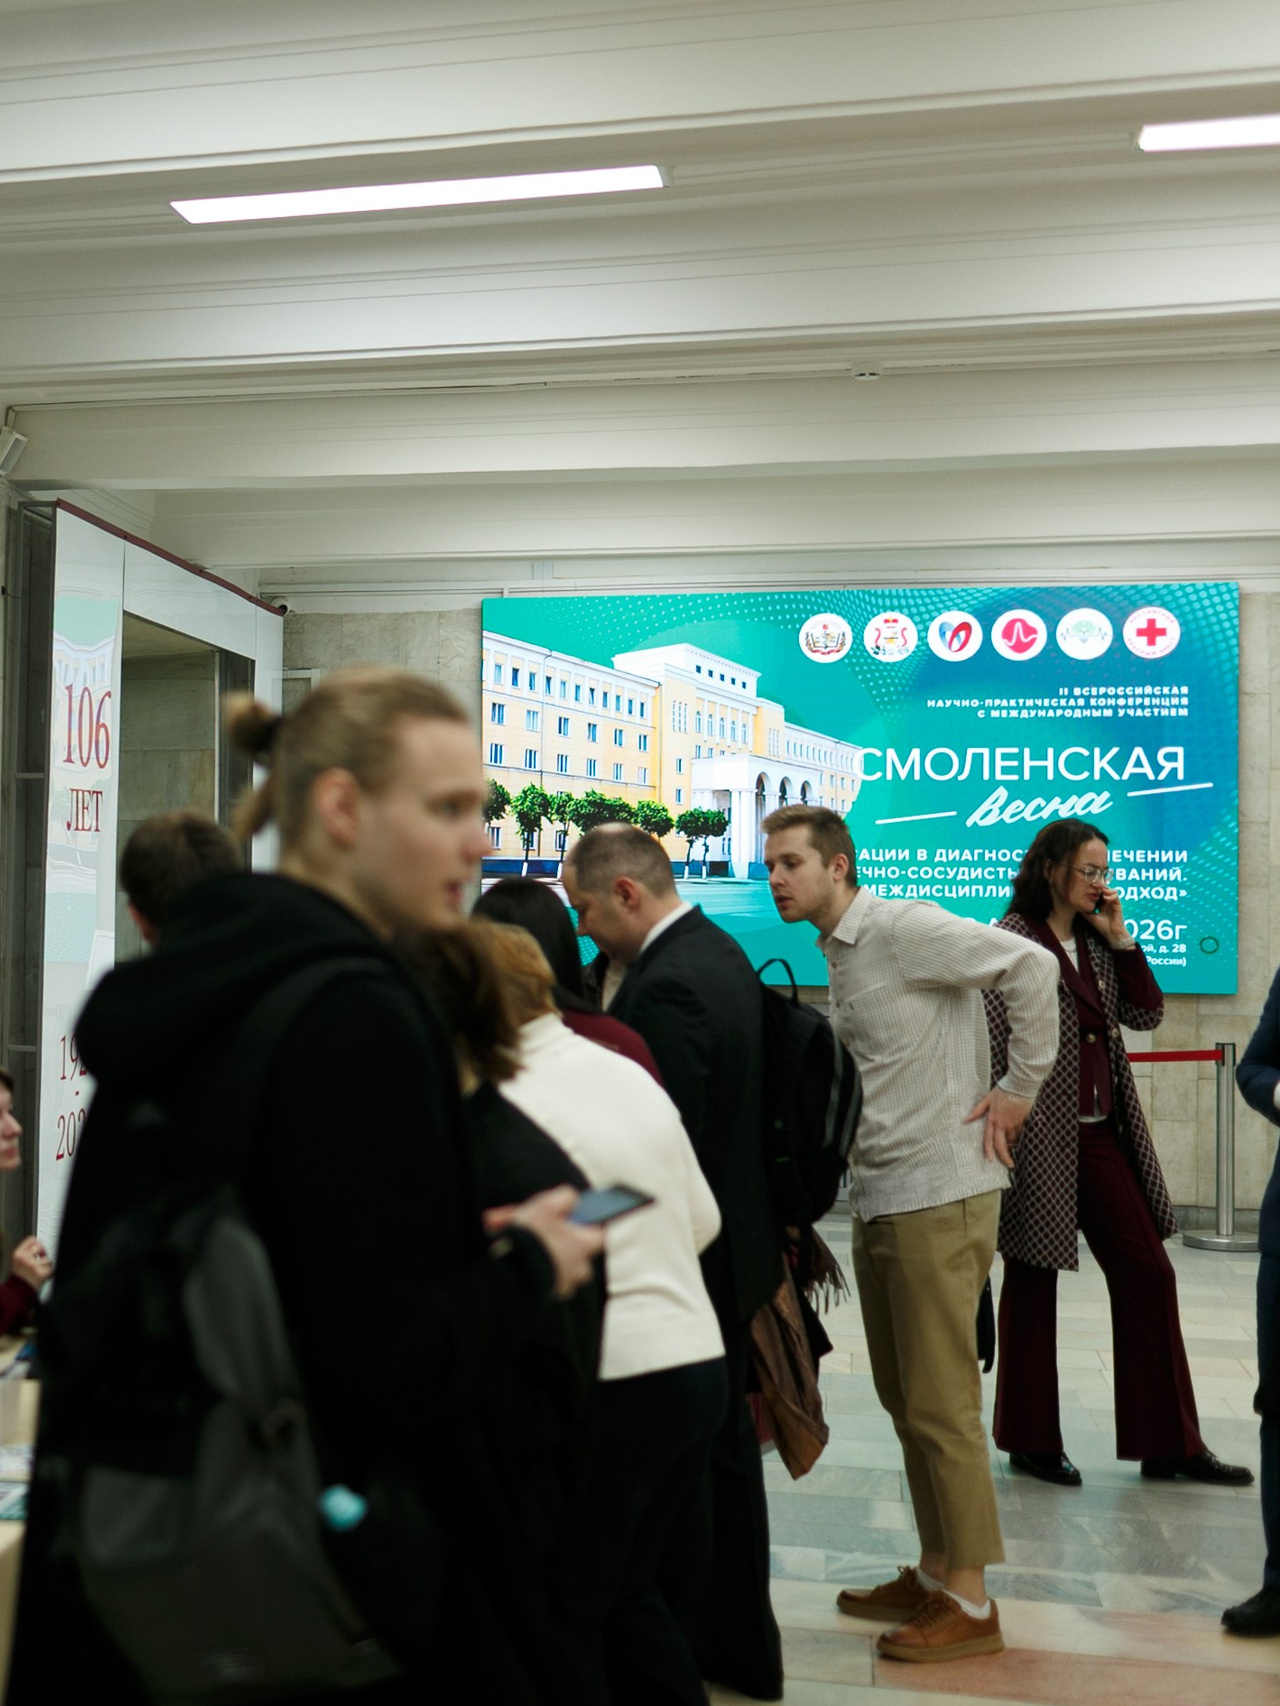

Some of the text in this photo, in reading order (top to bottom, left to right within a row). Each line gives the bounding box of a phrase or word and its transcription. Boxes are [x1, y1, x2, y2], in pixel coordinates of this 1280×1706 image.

[1059, 685, 1189, 696] II ВСЕРОССИЙСКАЯ
[927, 697, 1189, 708] НАУЧНО-ПРАКТИЧЕСКАЯ КОНФЕРЕНЦИЯ
[977, 707, 1189, 719] С МЕЖДУНАРОДНЫМ УЧАСТИЕМ
[63, 683, 112, 769] 106
[854, 746, 1185, 783] СМОЛЕНСКАЯ
[67, 788, 103, 832] ЛЕТ
[856, 849, 910, 862] АЦИИ
[916, 849, 928, 861] В
[856, 866, 1188, 881] ЕЧНО-СОСУДИСТЫ ВАНИЙ.
[863, 884, 1188, 901] МЕЖДИСЦИПЛИ ОДХОД»
[1123, 919, 1188, 940] 026г
[1141, 944, 1156, 954] ой,
[1172, 943, 1187, 953] 28
